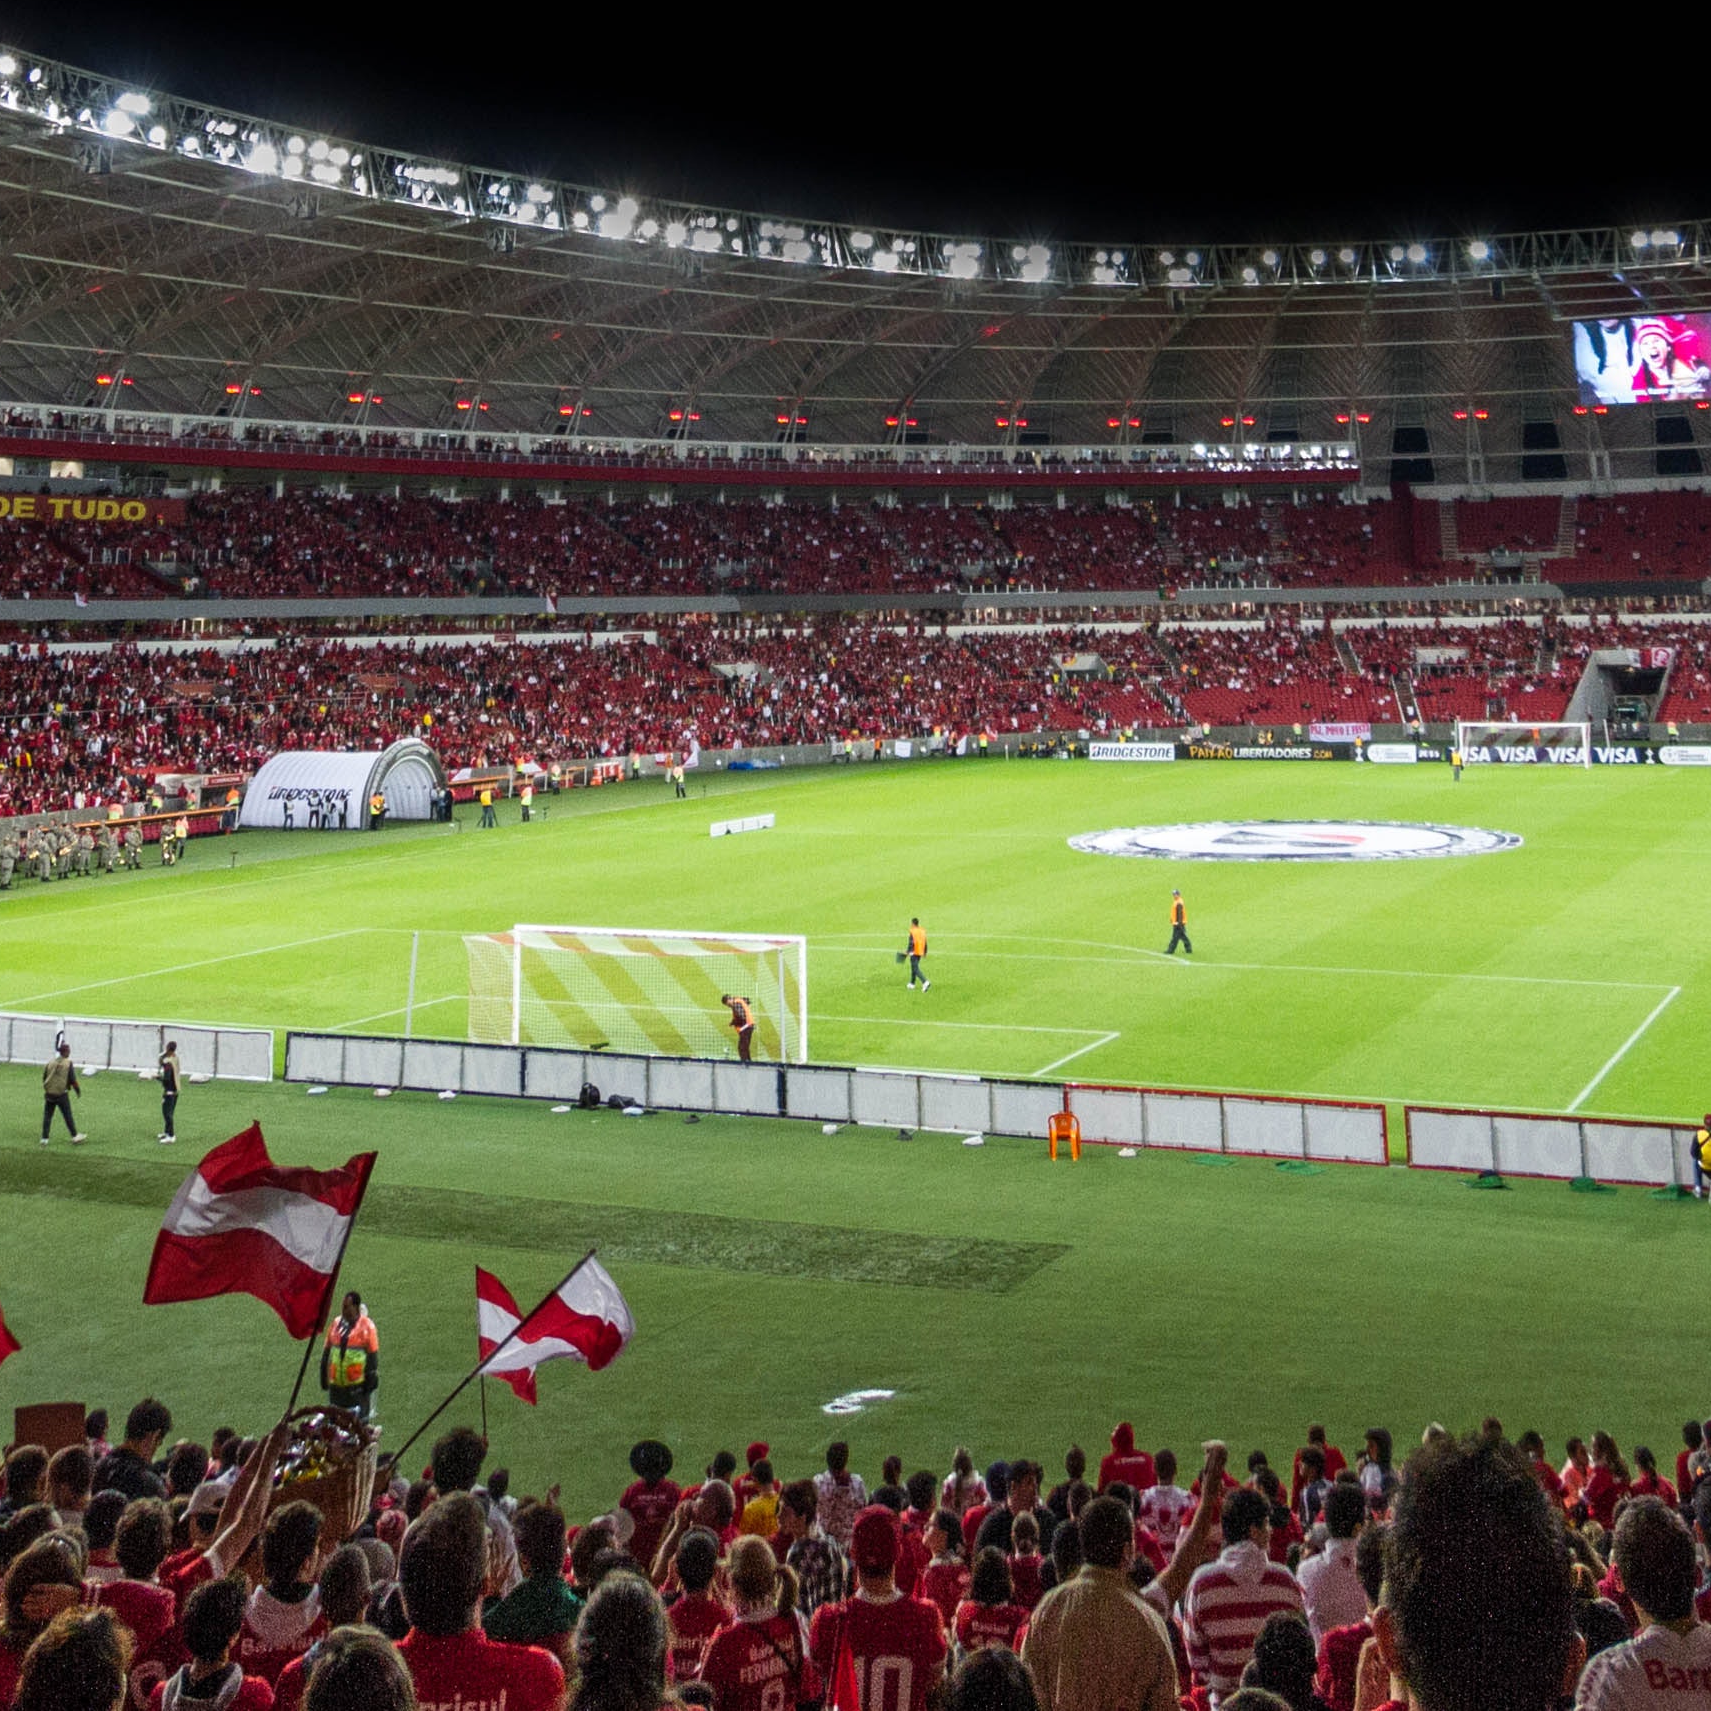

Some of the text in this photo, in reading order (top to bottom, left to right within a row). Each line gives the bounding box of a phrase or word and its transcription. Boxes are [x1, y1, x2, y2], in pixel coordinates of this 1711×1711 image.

[48, 498, 147, 521] TUDO
[1092, 746, 1173, 758] BRIDGESTONE
[1234, 748, 1312, 759] LIBERTADORES
[1495, 747, 1537, 763] VISA
[1545, 747, 1587, 763] VISA
[1593, 747, 1638, 763] VISA
